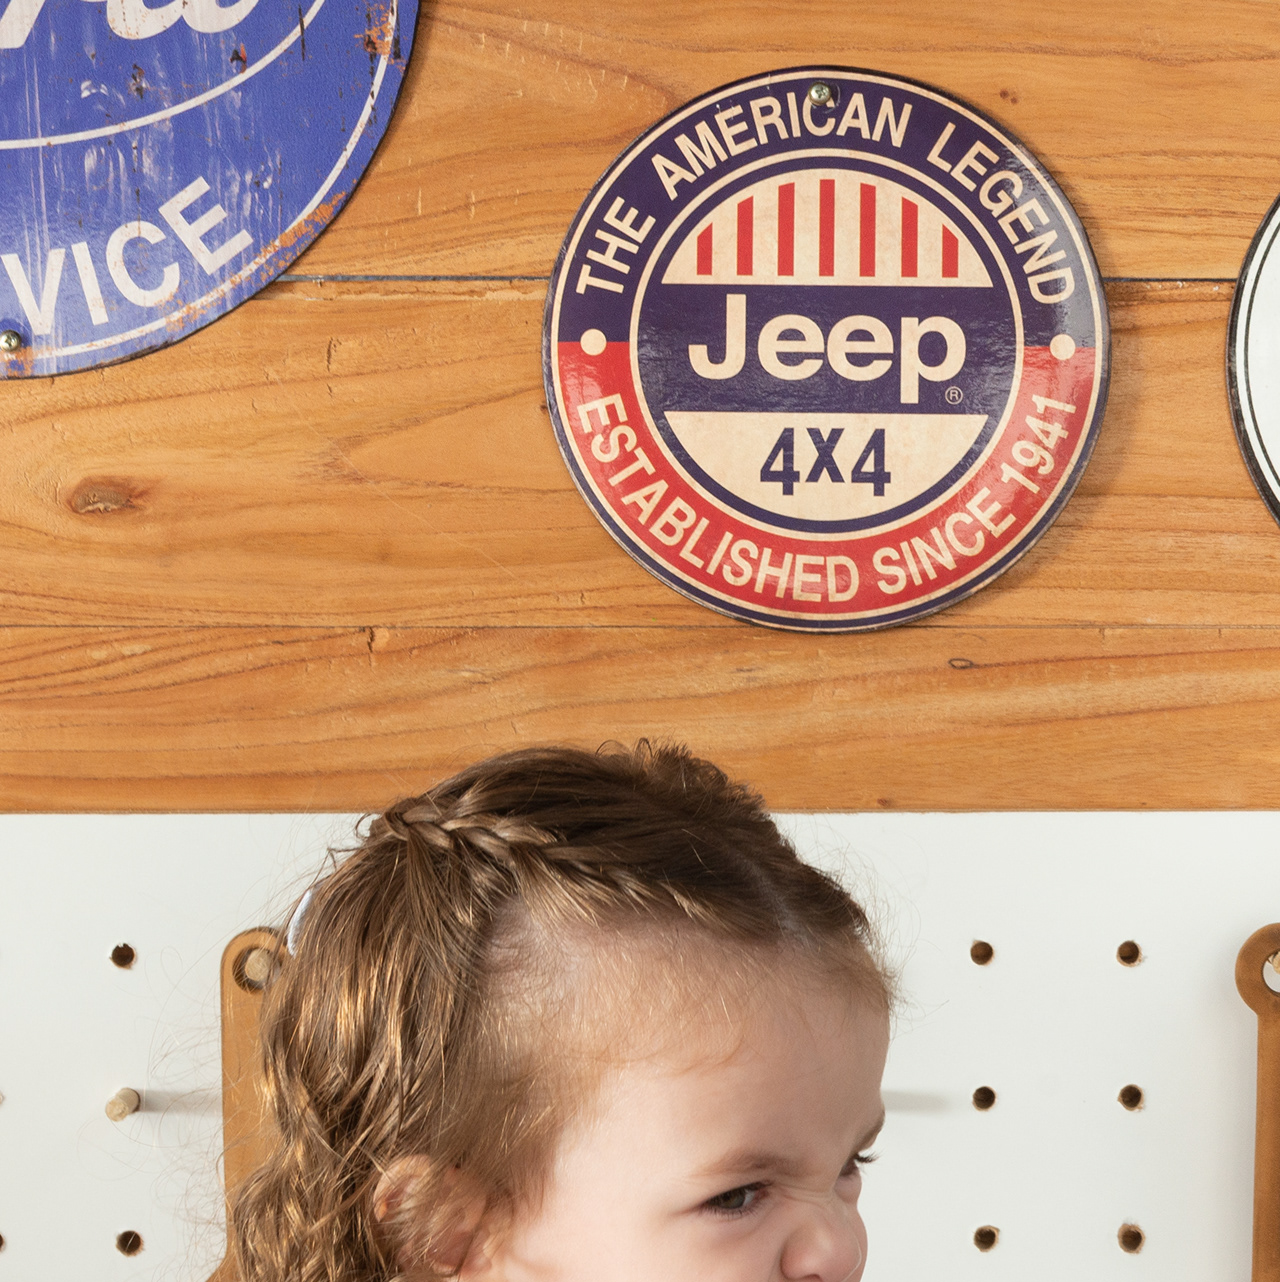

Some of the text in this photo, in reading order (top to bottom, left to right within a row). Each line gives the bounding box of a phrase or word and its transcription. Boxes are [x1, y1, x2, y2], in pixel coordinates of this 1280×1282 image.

[575, 91, 1075, 305] THE AMERICAN LEGEND
[688, 293, 967, 404] Jeep
[577, 393, 1077, 603] ESTABLISHED SINCE 1941
[760, 427, 891, 497] 4X4
